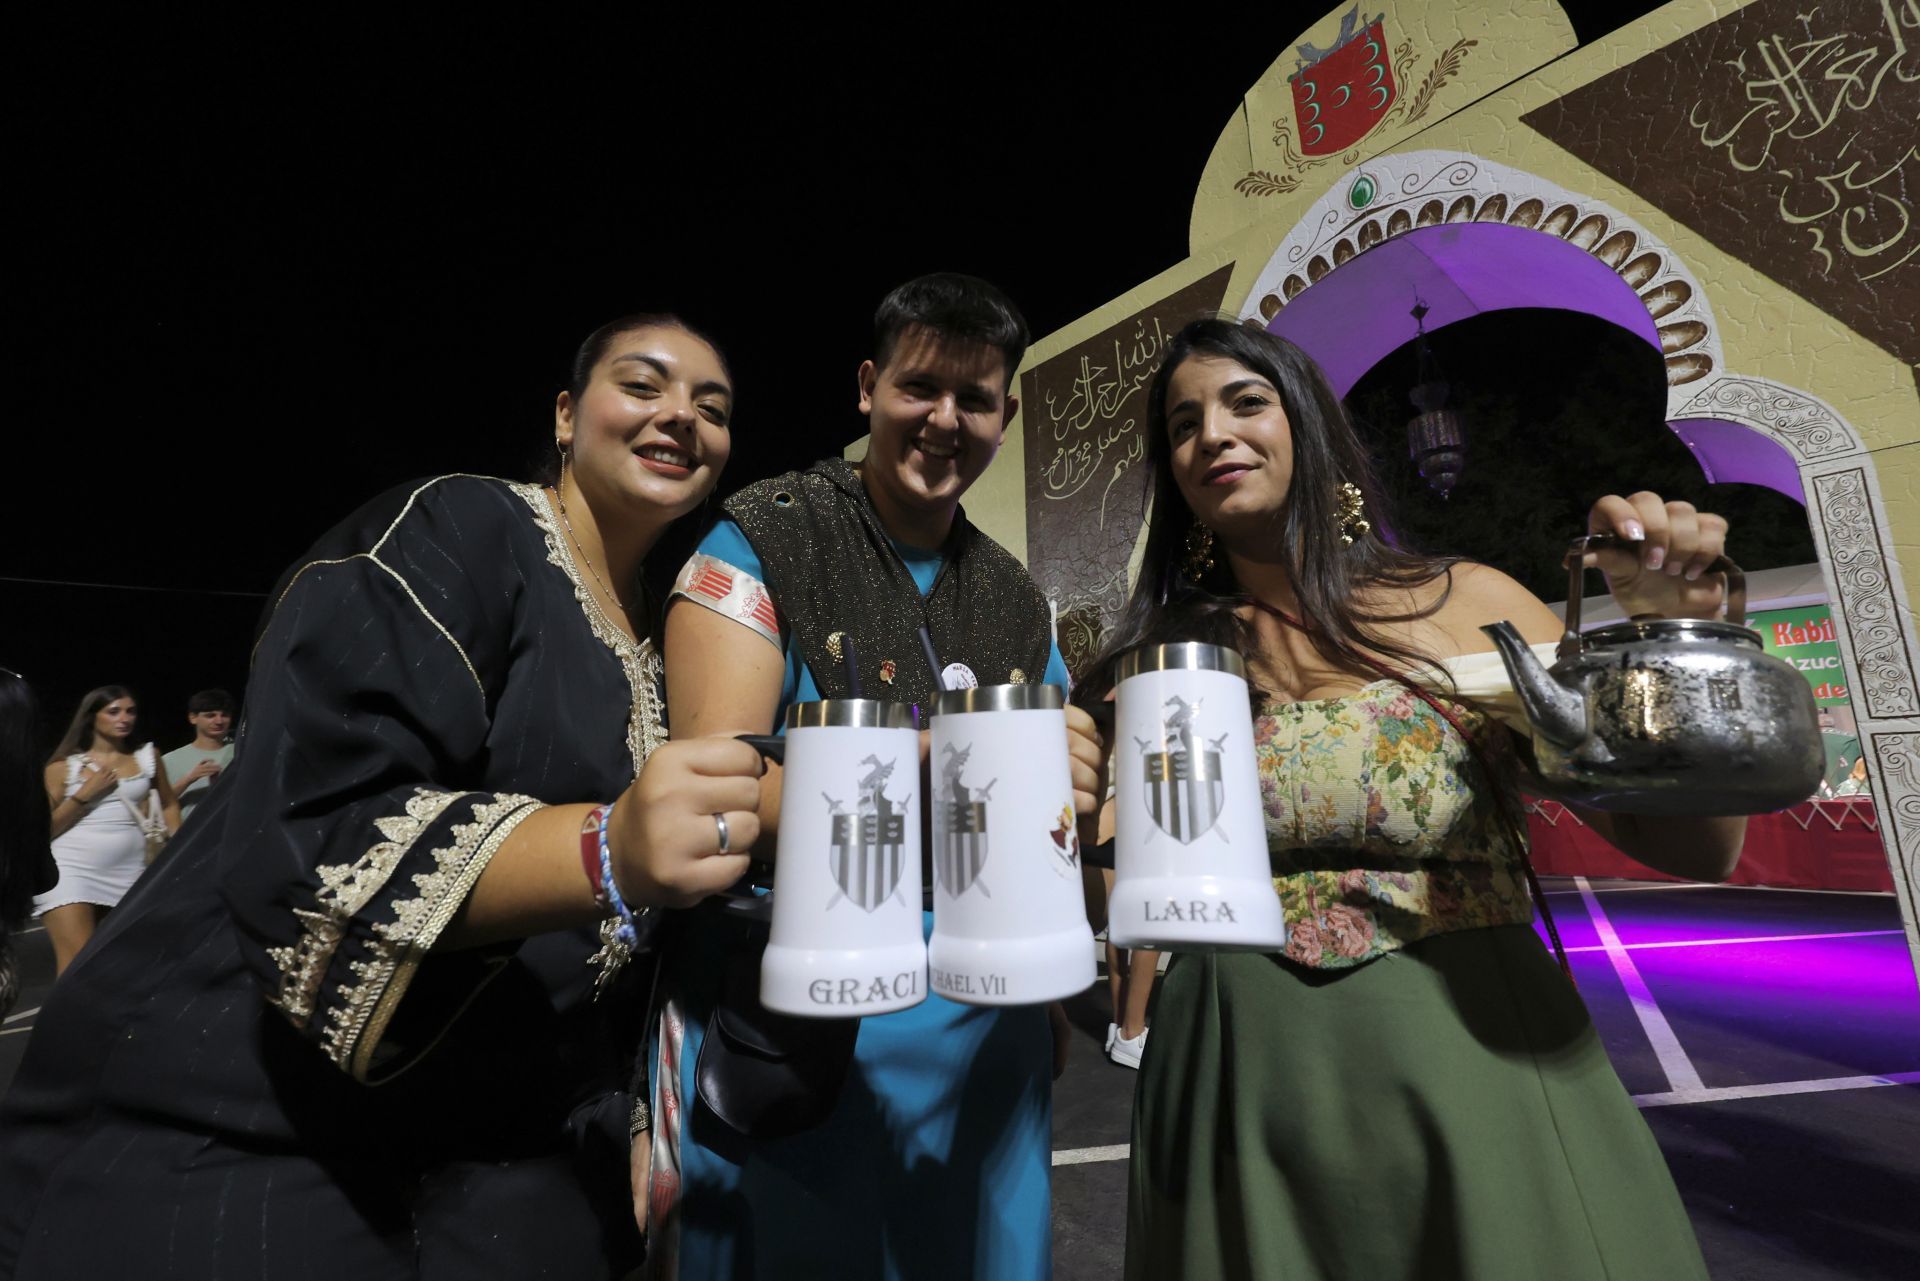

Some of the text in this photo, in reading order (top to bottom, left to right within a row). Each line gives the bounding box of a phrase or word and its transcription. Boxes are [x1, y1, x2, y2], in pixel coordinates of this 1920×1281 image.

[1143, 901, 1239, 923] LARA
[808, 971, 917, 1005] GRACI
[981, 974, 1008, 996] VII
